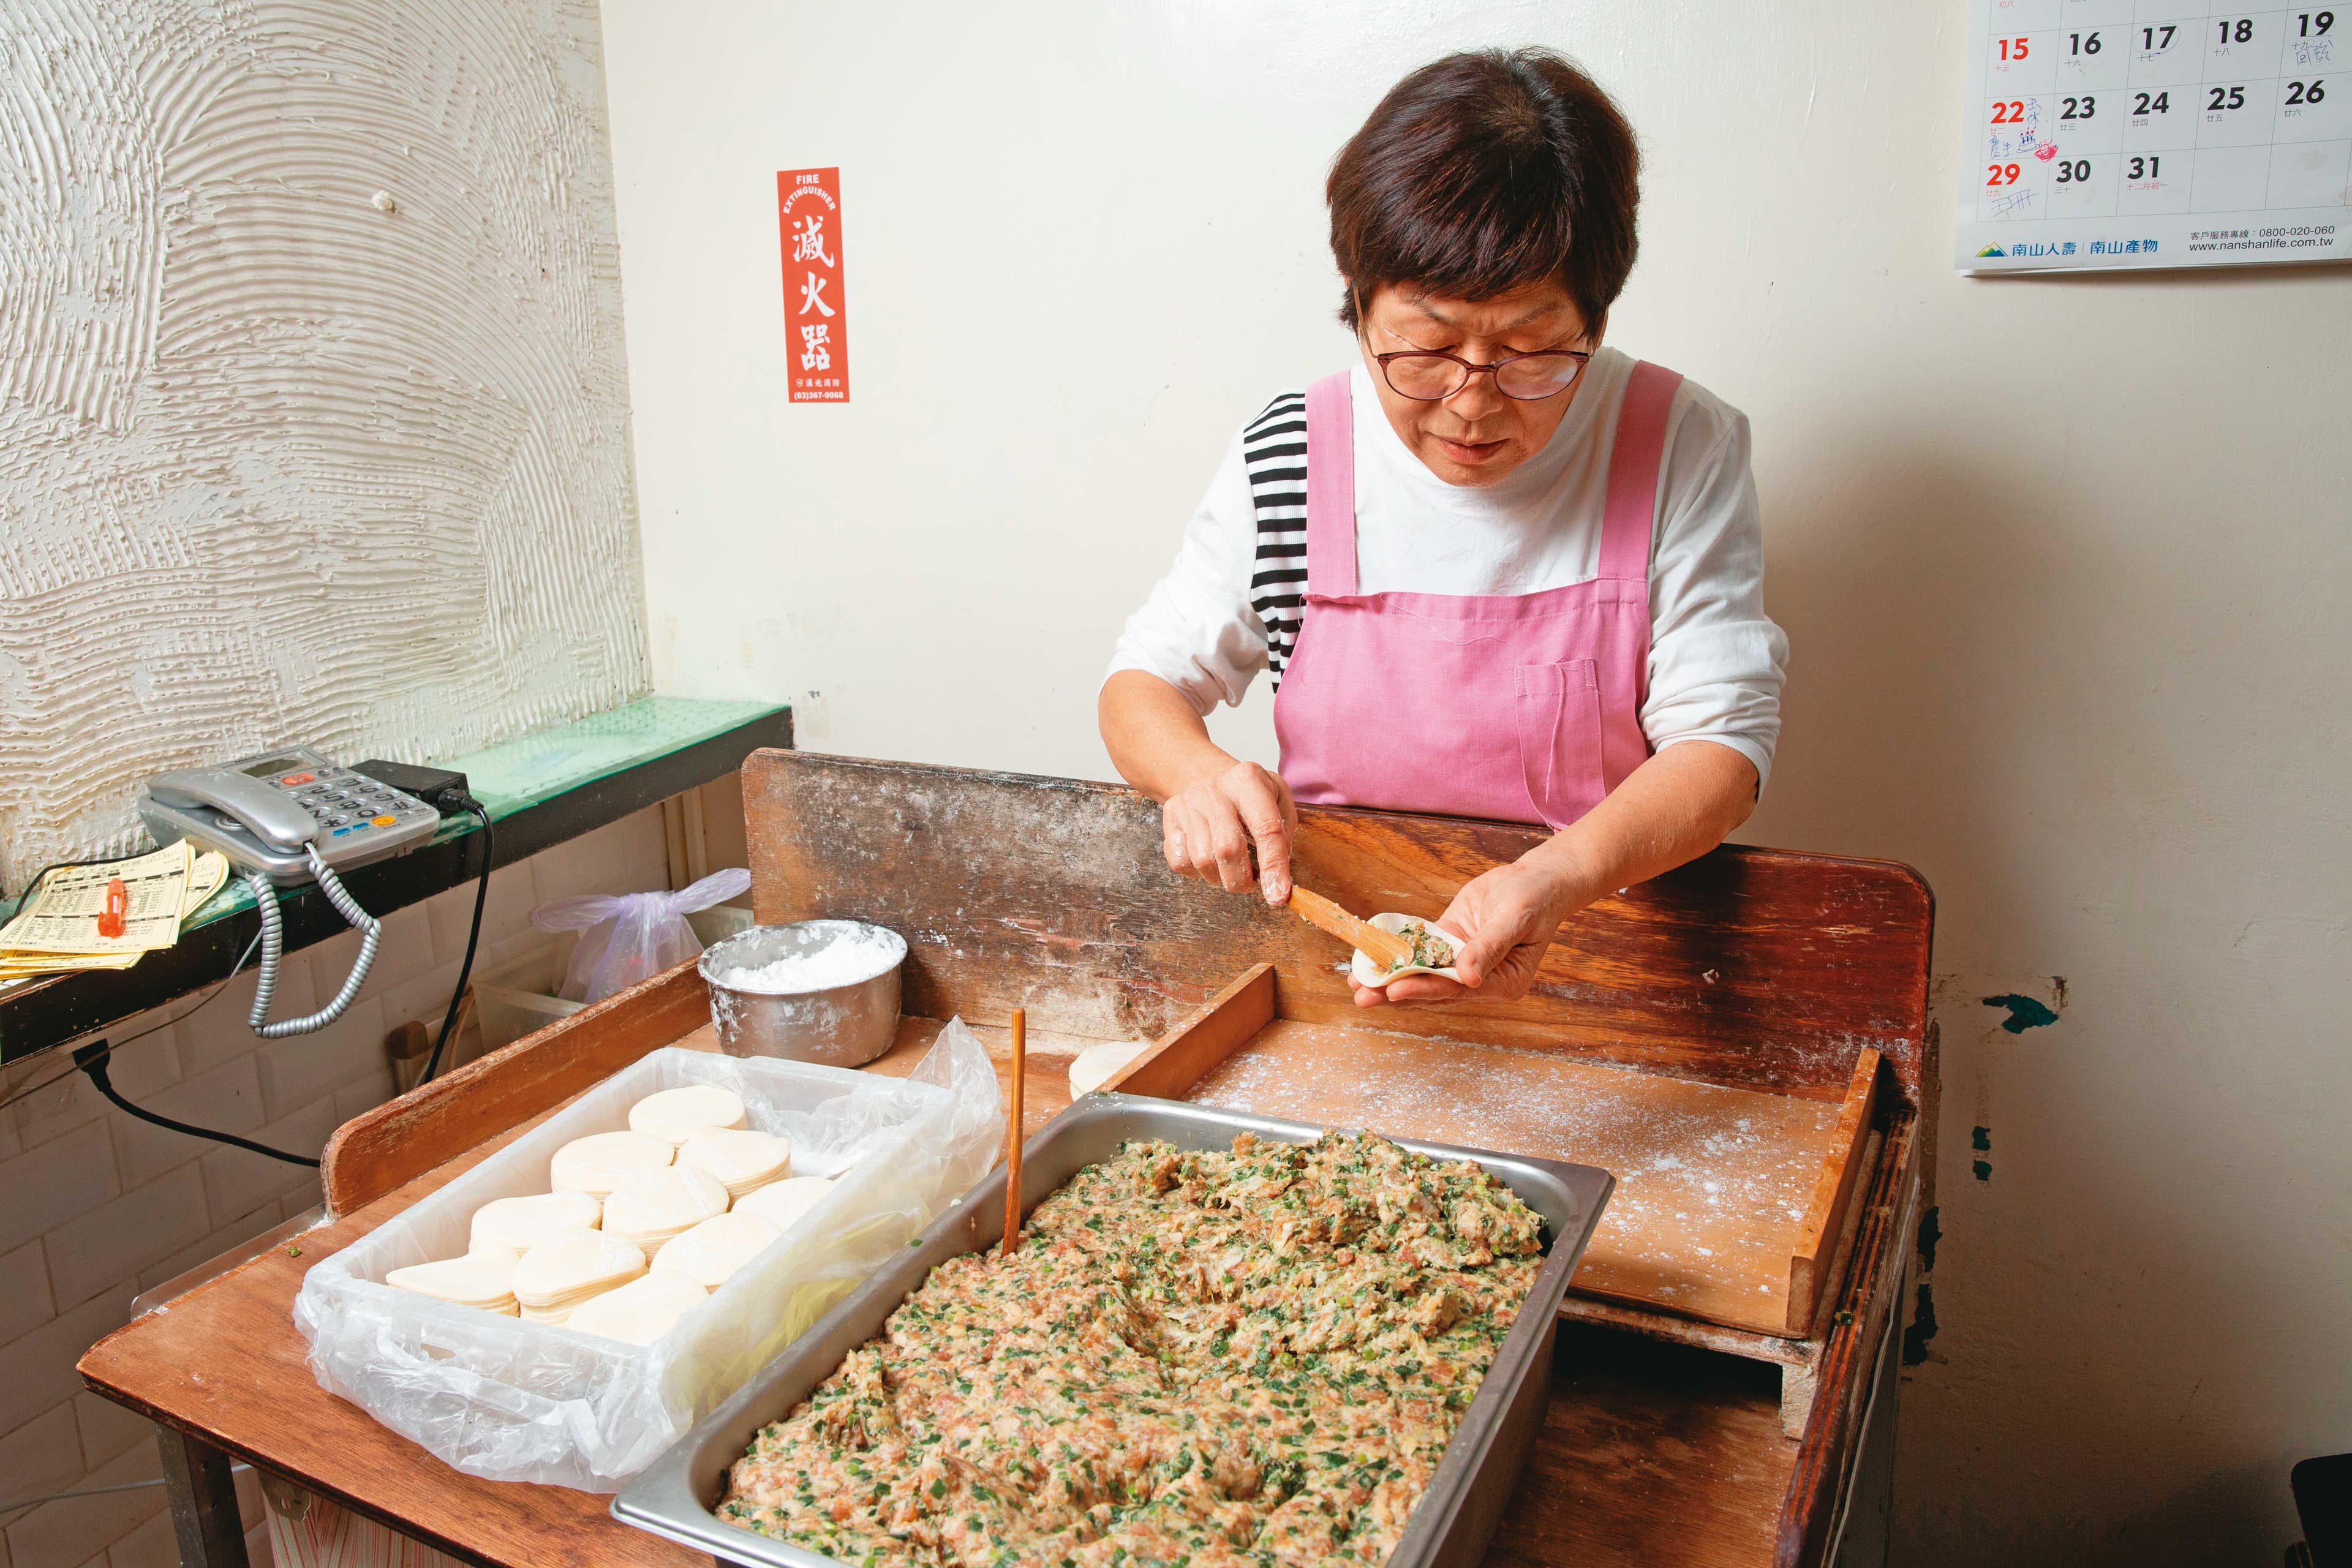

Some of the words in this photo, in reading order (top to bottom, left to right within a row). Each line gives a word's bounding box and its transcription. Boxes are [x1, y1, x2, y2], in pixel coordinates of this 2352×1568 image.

[1999, 37, 2029, 61] 15
[2069, 32, 2101, 55] 16
[2143, 26, 2177, 50] 17
[2218, 19, 2253, 44] 18
[2298, 11, 2334, 37] 19
[1994, 64, 2010, 73] 十五
[2137, 54, 2155, 62] 十七
[2213, 48, 2230, 56] 十八
[2291, 40, 2310, 50] 十九
[1991, 101, 2024, 124] 22
[2060, 96, 2095, 119] 23
[2133, 92, 2169, 115] 24
[2207, 86, 2245, 110] 25
[2285, 80, 2324, 105] 26
[2206, 114, 2223, 123] 廿五
[2283, 108, 2302, 117] 廿六
[796, 174, 820, 185] FIRE
[1986, 164, 2021, 186] 29
[2056, 160, 2091, 183] 30
[2127, 157, 2159, 179] 31
[783, 186, 836, 214] EXTINGUISHER
[2126, 182, 2168, 191] 十二月初一
[2012, 241, 2076, 257] 南山人壽
[2089, 239, 2158, 255] 南山產物
[2189, 237, 2334, 251] www.nanshanlife.com.tw
[791, 214, 836, 371] 滅火器
